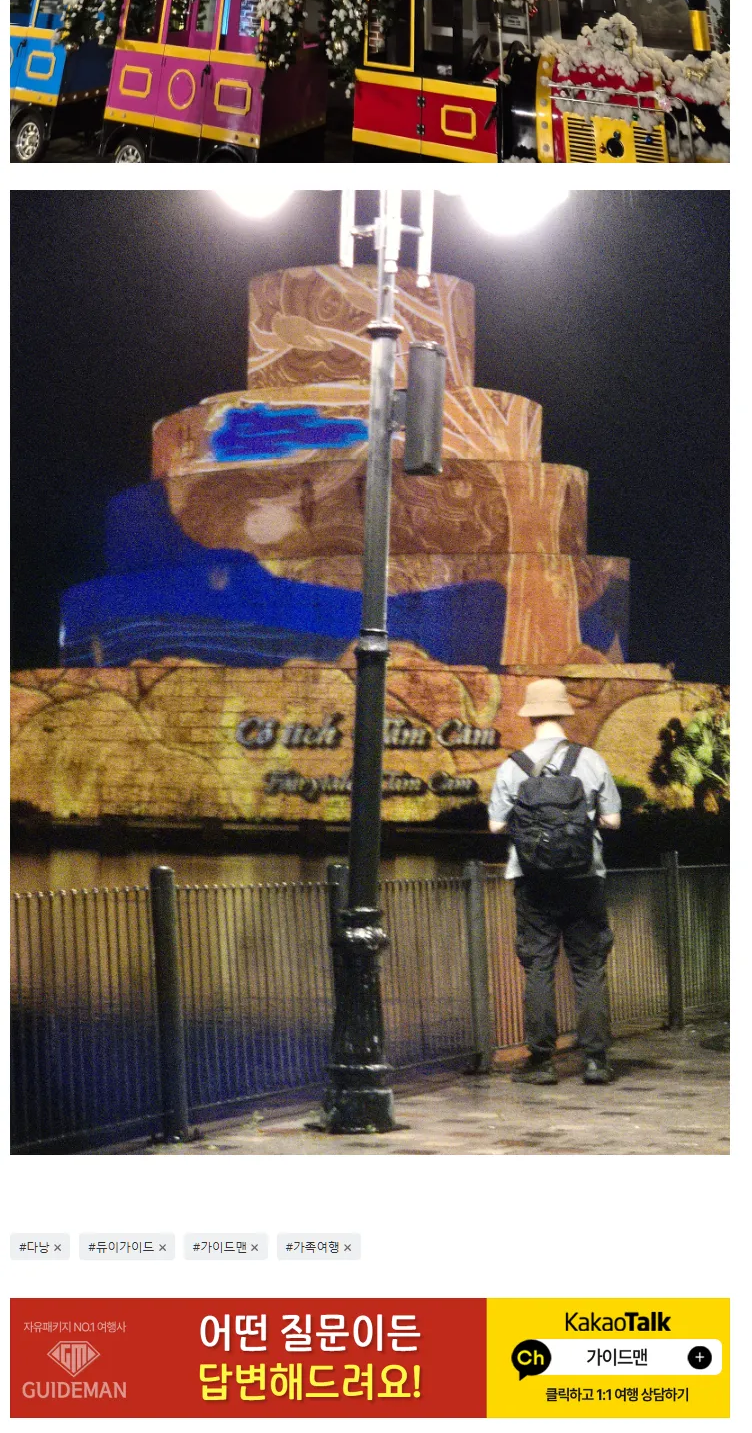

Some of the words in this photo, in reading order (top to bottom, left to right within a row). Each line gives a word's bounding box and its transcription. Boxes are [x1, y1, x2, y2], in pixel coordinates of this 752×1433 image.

[18, 1241, 51, 1254] #다낭
[87, 1241, 155, 1254] #듀이가이드
[192, 1241, 248, 1254] #가이드맨
[285, 1240, 340, 1254] #가족여행
[23, 1320, 72, 1333] 자유패키지
[96, 1320, 127, 1334] 여행사
[565, 1311, 672, 1332] KakaoTalk
[199, 1313, 268, 1352] 어떤
[280, 1313, 421, 1352] 질문이든
[517, 1349, 545, 1366] Ch
[586, 1347, 648, 1367] 가이드맨
[199, 1362, 422, 1401] 답변해드려요!
[21, 1381, 127, 1399] GUIDEMAN
[545, 1387, 594, 1402] 클릭하고
[596, 1388, 612, 1401] 1:1
[614, 1387, 639, 1402] 여행
[640, 1387, 689, 1402] 상담하기
